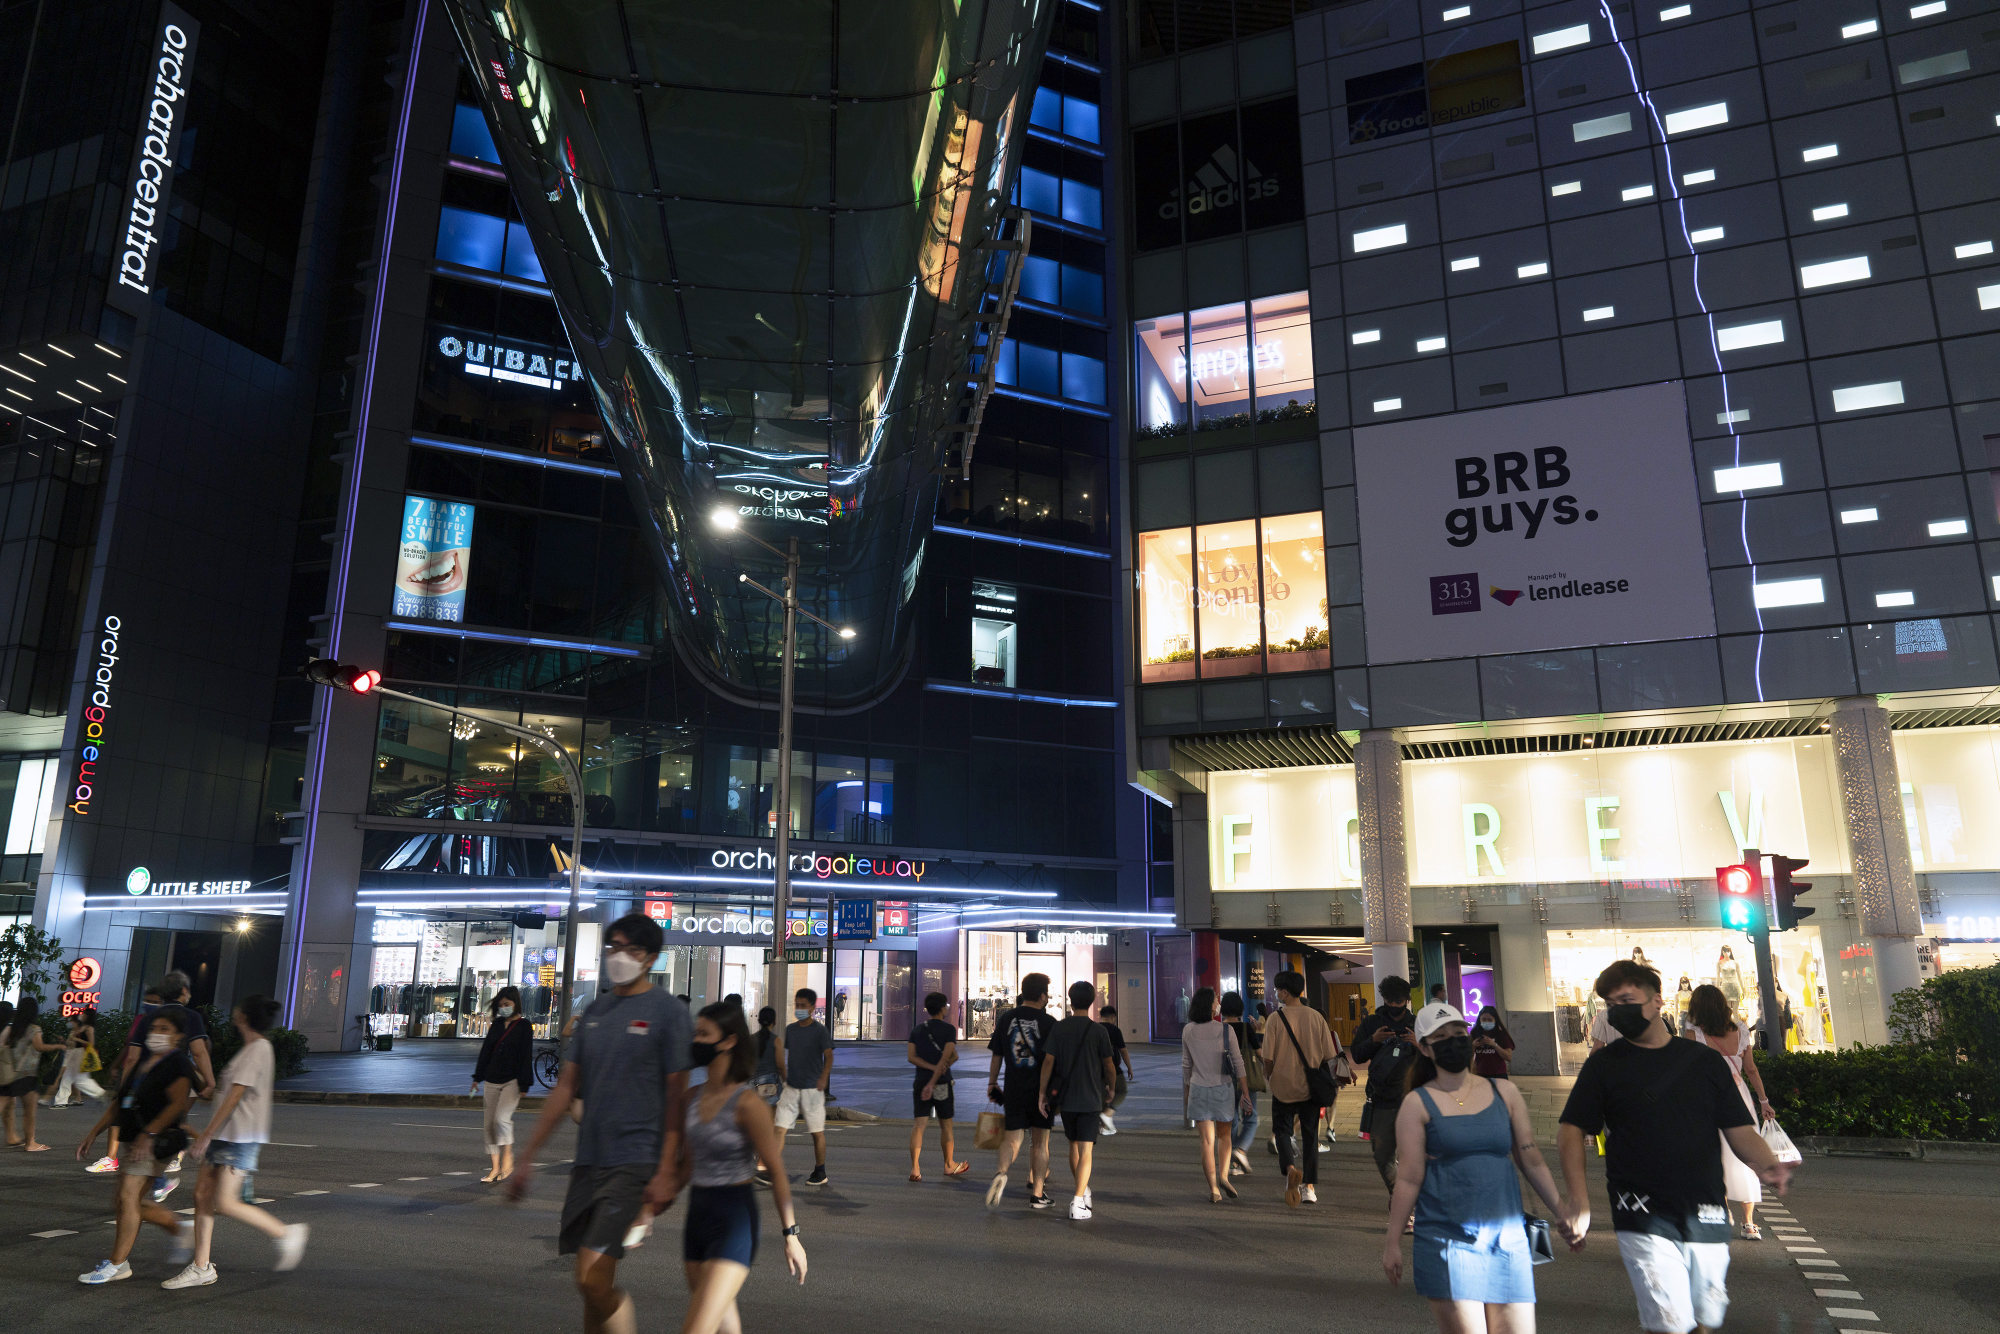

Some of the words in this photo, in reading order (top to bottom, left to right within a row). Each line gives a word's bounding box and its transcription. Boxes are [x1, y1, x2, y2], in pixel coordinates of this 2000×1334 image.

[1379, 113, 1428, 134] food
[1432, 97, 1500, 122] republic
[119, 24, 187, 294] orchardcentral
[1455, 446, 1571, 499] BRB
[411, 499, 425, 517] 7
[429, 501, 467, 517] DAYS
[408, 516, 466, 532] BEAUTIFUL
[1445, 495, 1599, 547] guys.
[405, 524, 465, 546] SMILE
[1528, 573, 1557, 581] Managed
[1558, 571, 1567, 580] by
[1438, 580, 1472, 601] 313
[1529, 578, 1630, 601] lendlease
[396, 602, 458, 622] 67385833
[69, 615, 121, 815] orchardgateway
[711, 847, 925, 883] orchrdgateway
[151, 881, 199, 896] LITTLE
[202, 880, 252, 895] SHEEP
[888, 926, 905, 934] MRT
[766, 950, 806, 962] OARD
[808, 950, 819, 961] RD
[62, 991, 101, 1003] OCBC
